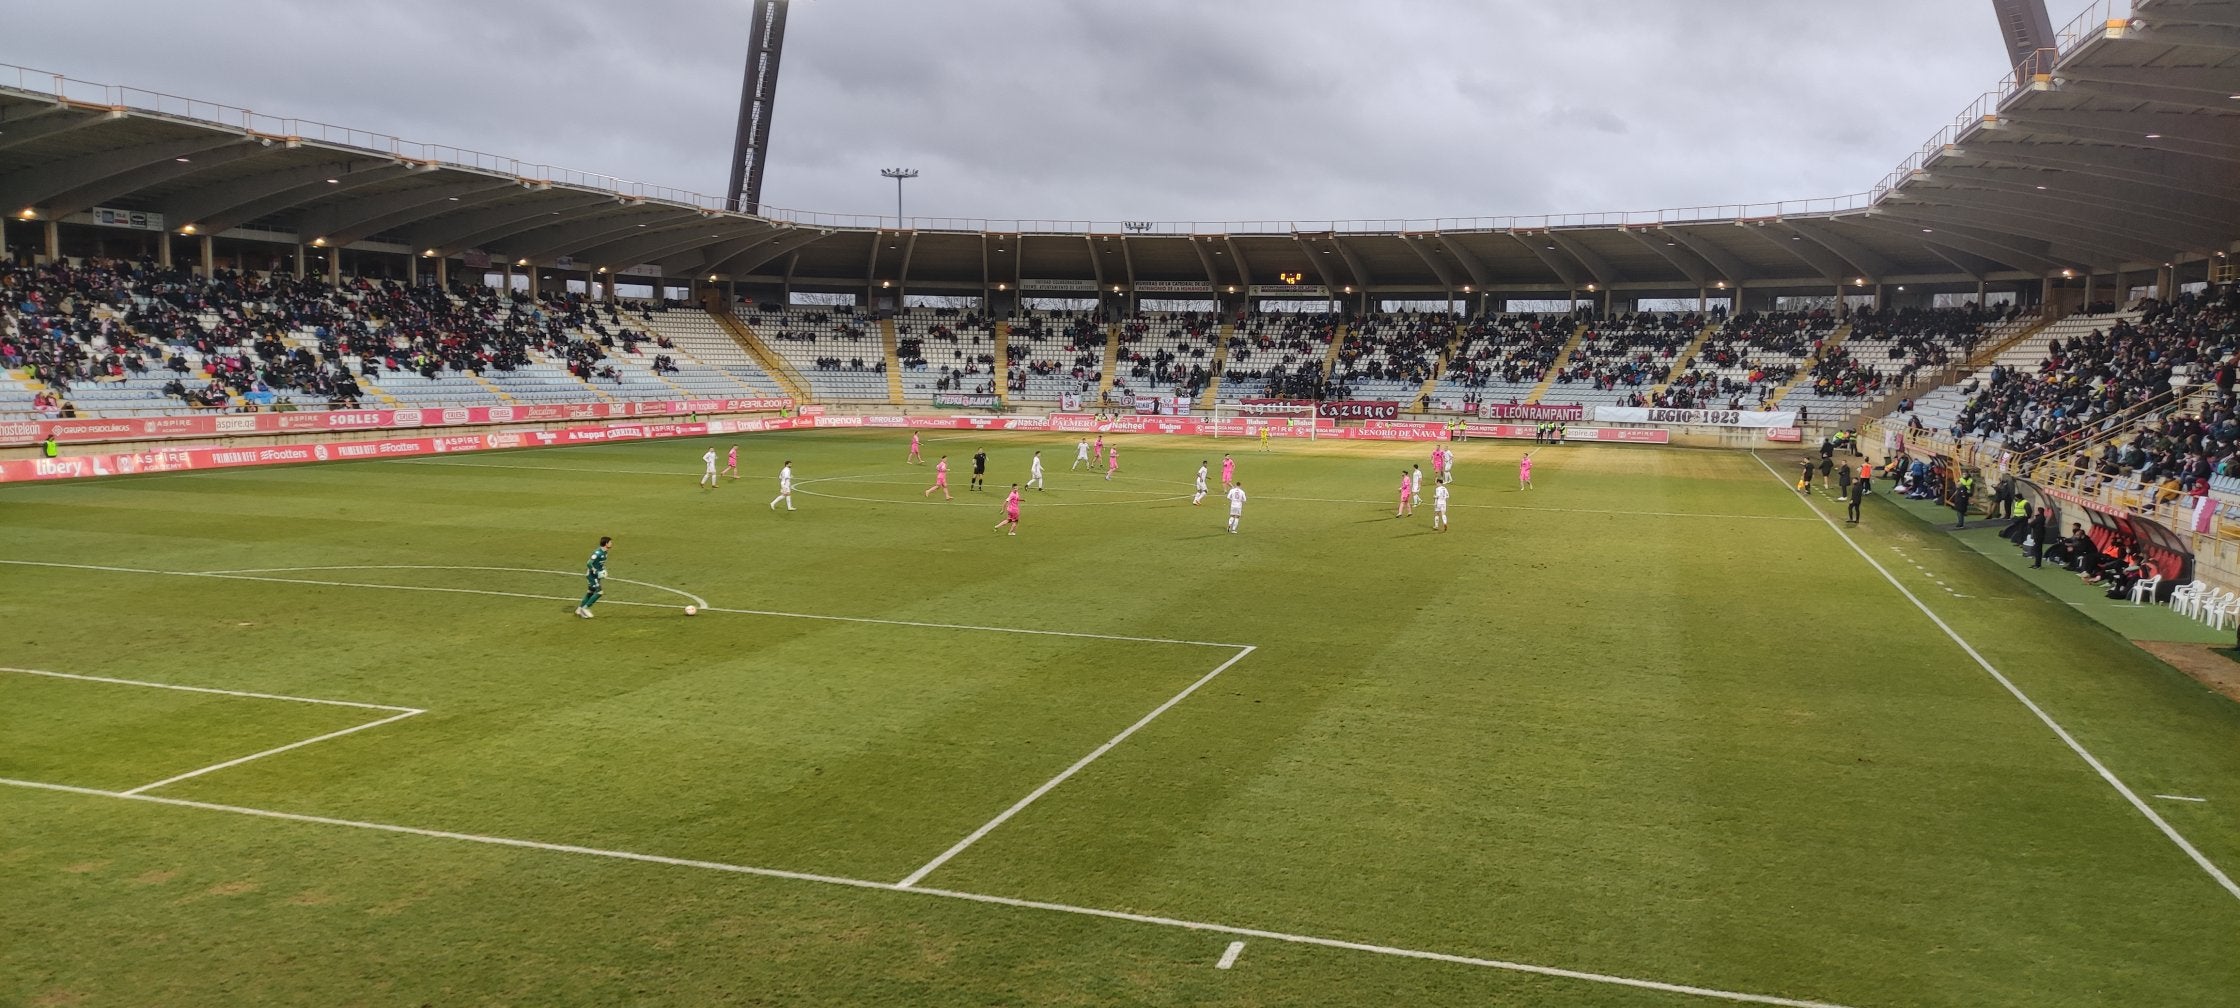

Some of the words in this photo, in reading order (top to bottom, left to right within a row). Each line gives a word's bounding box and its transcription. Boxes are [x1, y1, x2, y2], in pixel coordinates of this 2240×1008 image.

[1490, 406, 1502, 418] EL
[1504, 404, 1530, 419] LEÓN
[1530, 407, 1582, 421] RAMPANTE
[1647, 410, 1691, 424] LEGIO
[216, 419, 255, 429] aspire.qa
[329, 414, 380, 425] SORLES
[1112, 422, 1145, 430] Nakheel
[577, 431, 605, 440] Kappa
[1412, 429, 1437, 438] NAVA
[446, 436, 480, 444] ASPIRE
[134, 452, 188, 464] ASPIRE
[268, 450, 308, 460] Footters
[37, 458, 82, 477] libery
